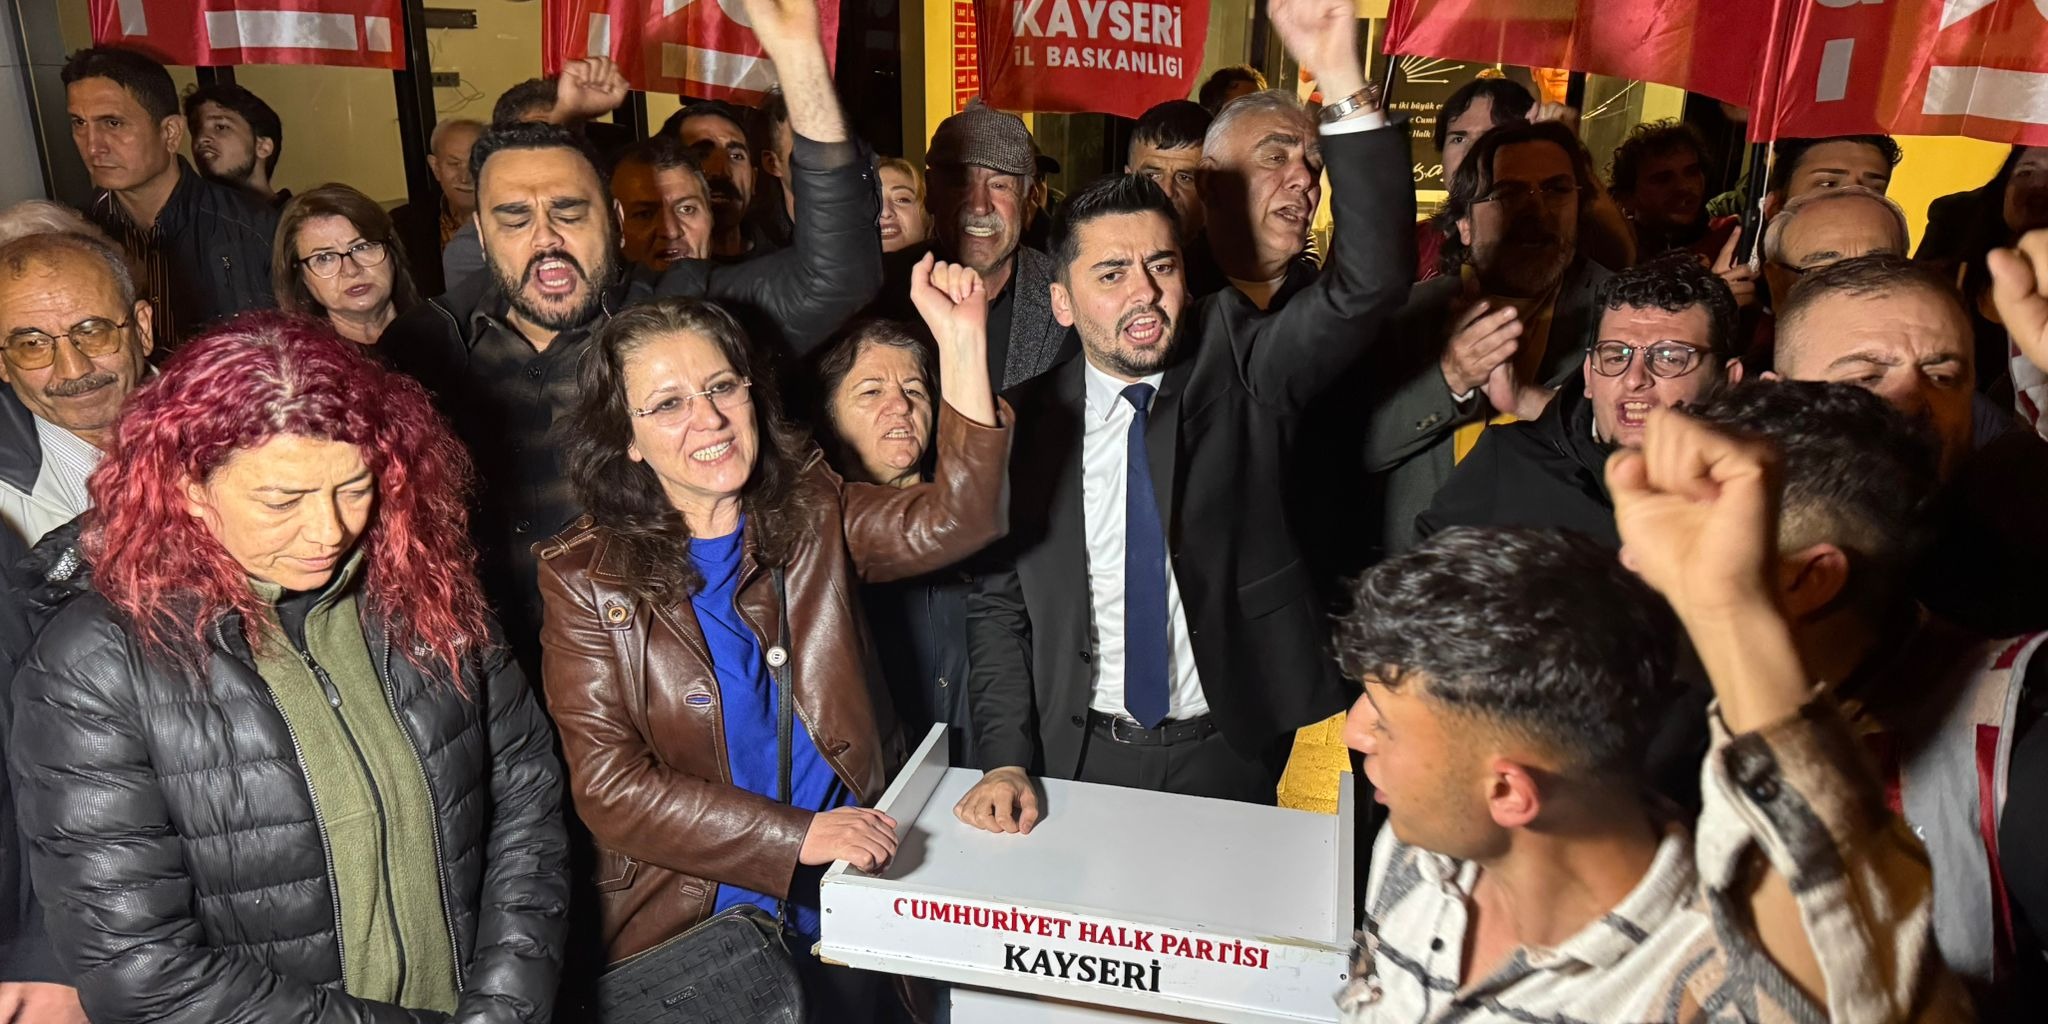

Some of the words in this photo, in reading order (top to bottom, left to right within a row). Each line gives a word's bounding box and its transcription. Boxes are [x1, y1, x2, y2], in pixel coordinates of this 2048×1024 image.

[1012, 0, 1183, 48] KAYSERİ
[1014, 46, 1035, 66] İL
[1046, 46, 1183, 80] BAŞKANLIĞI
[1399, 101, 1409, 110] iki
[1410, 101, 1434, 111] büyük
[1412, 129, 1430, 138] Halk
[893, 897, 1072, 940] CUMHURİYET
[1078, 921, 1154, 953] HALK
[1003, 942, 1162, 993] KAYSERİ
